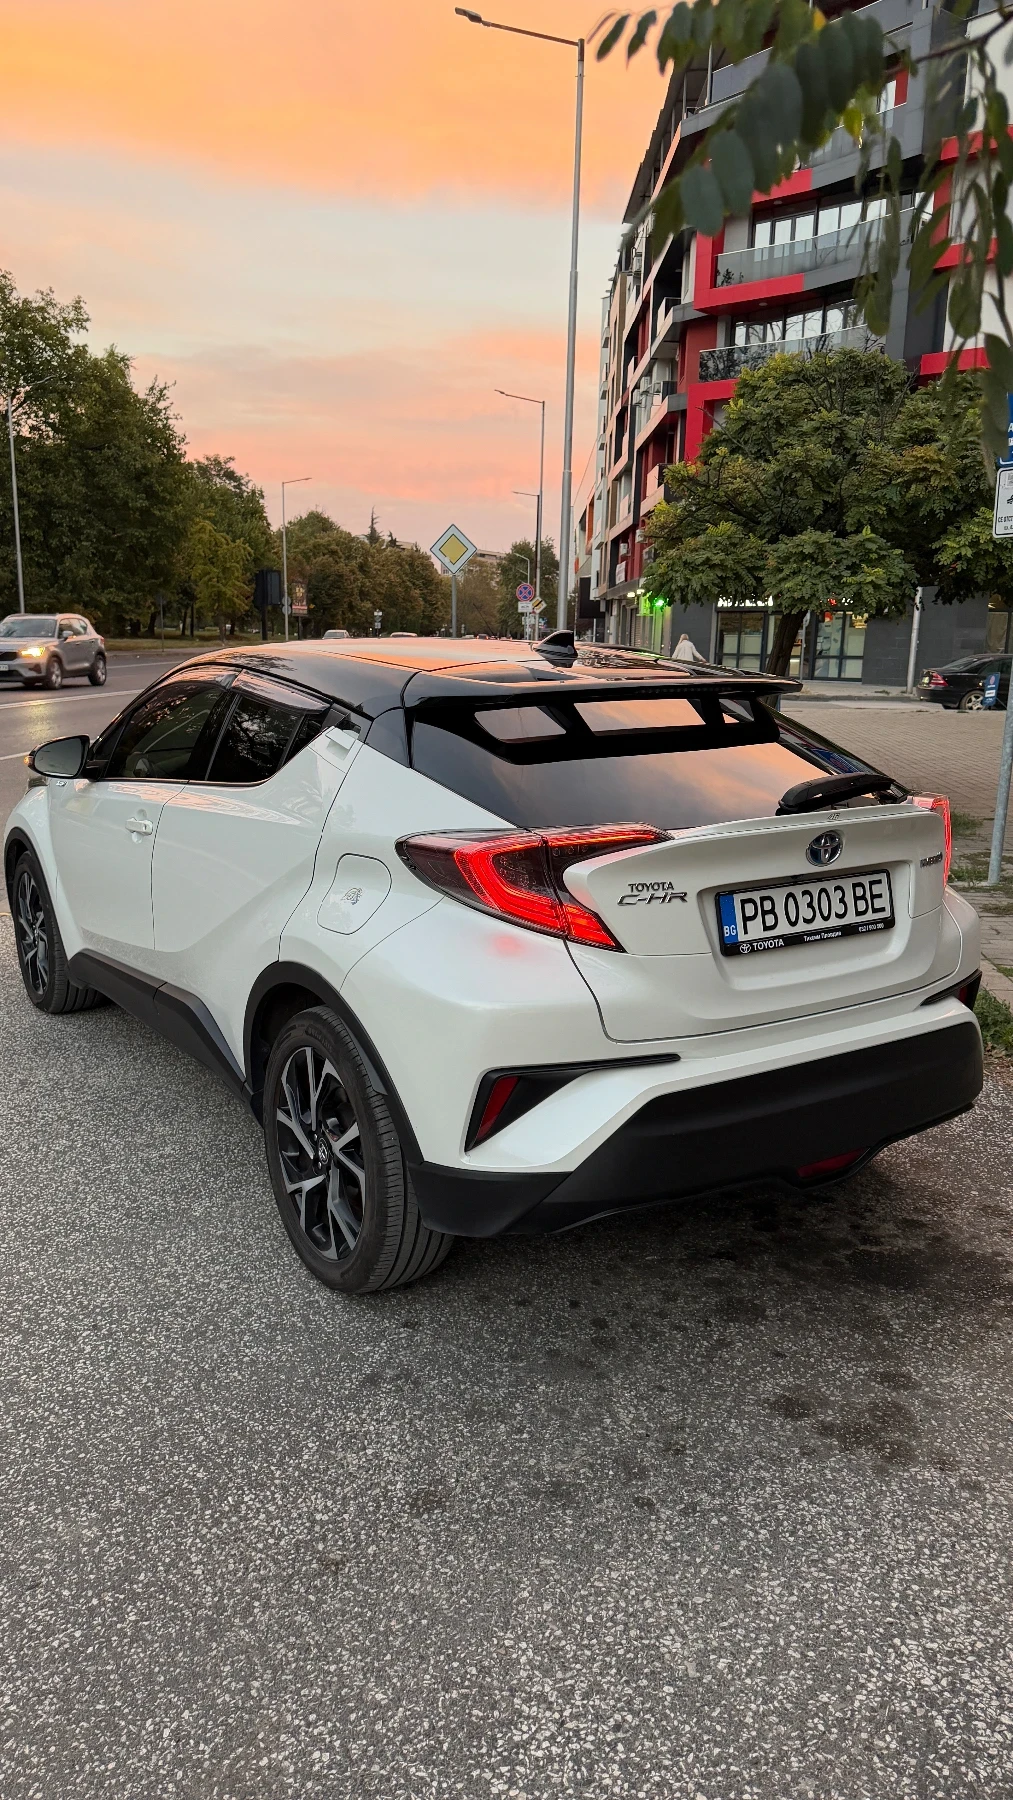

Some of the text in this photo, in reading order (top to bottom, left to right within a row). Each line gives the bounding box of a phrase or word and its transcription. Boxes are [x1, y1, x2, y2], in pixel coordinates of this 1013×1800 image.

[628, 881, 674, 893] TOYOTA
[617, 891, 688, 906] C-HR
[740, 879, 886, 935] PB 0303 BE
[723, 925, 737, 937] BG
[753, 938, 785, 951] TOYOTA
